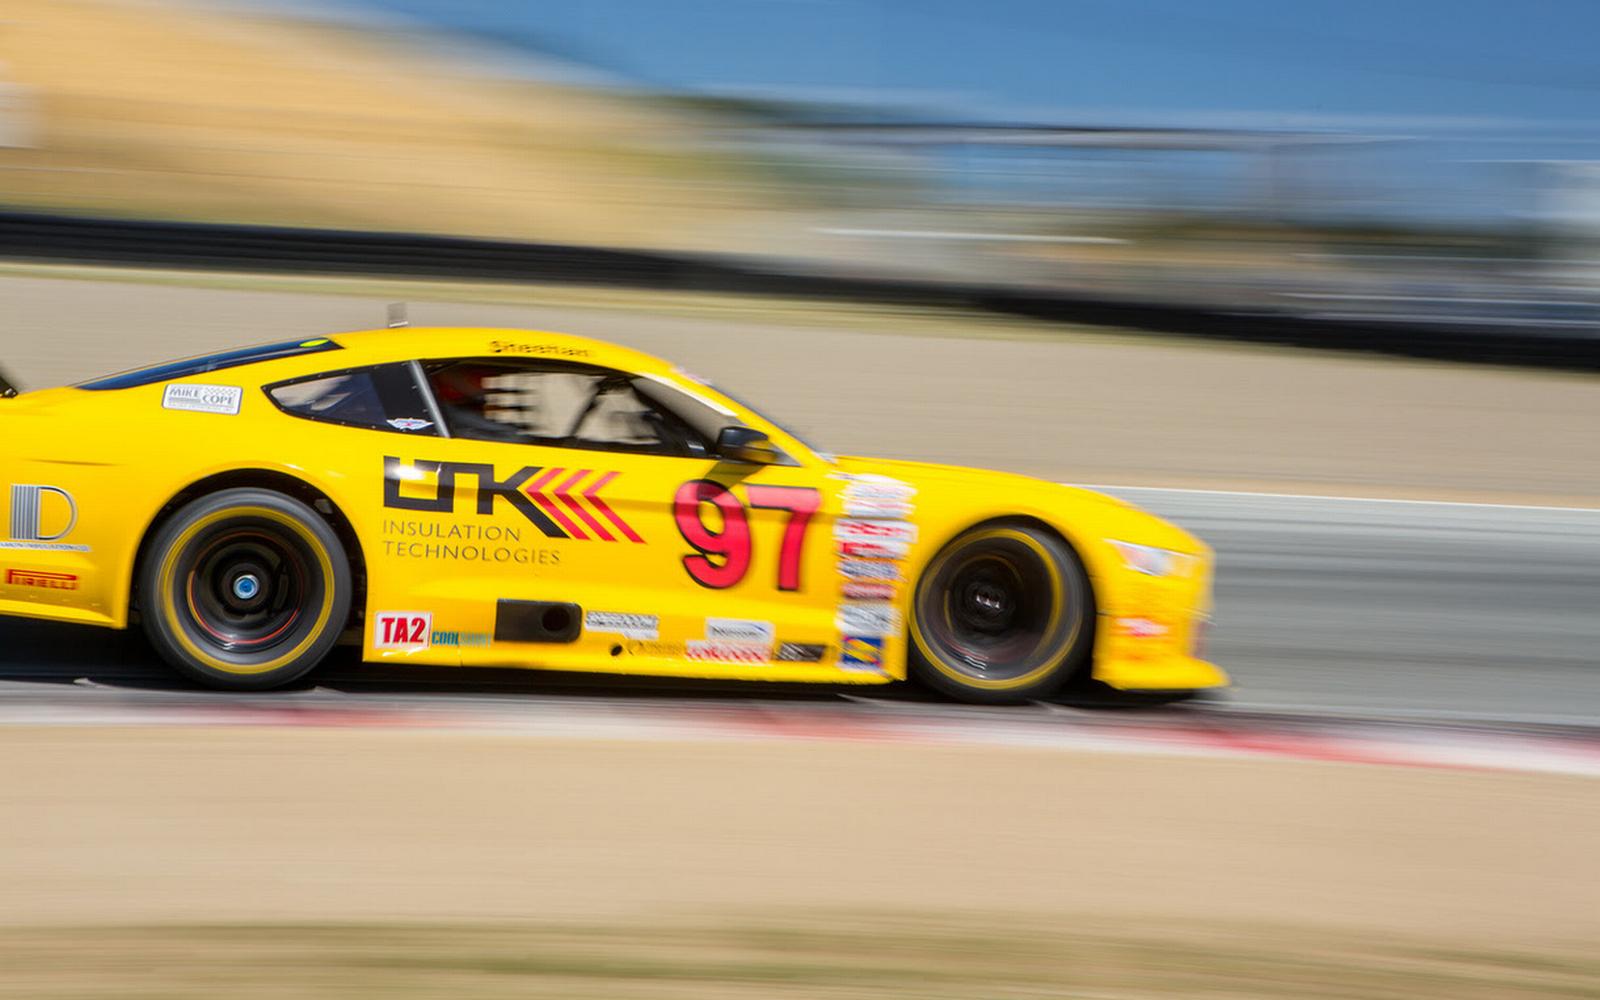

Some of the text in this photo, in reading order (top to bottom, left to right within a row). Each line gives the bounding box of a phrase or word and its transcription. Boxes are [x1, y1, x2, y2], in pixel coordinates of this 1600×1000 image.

[383, 519, 521, 542] INSULATION
[673, 478, 821, 592] 97
[383, 541, 561, 565] TECHNOLOGIES
[5, 569, 79, 590] PIRELLI
[382, 617, 426, 644] TA2
